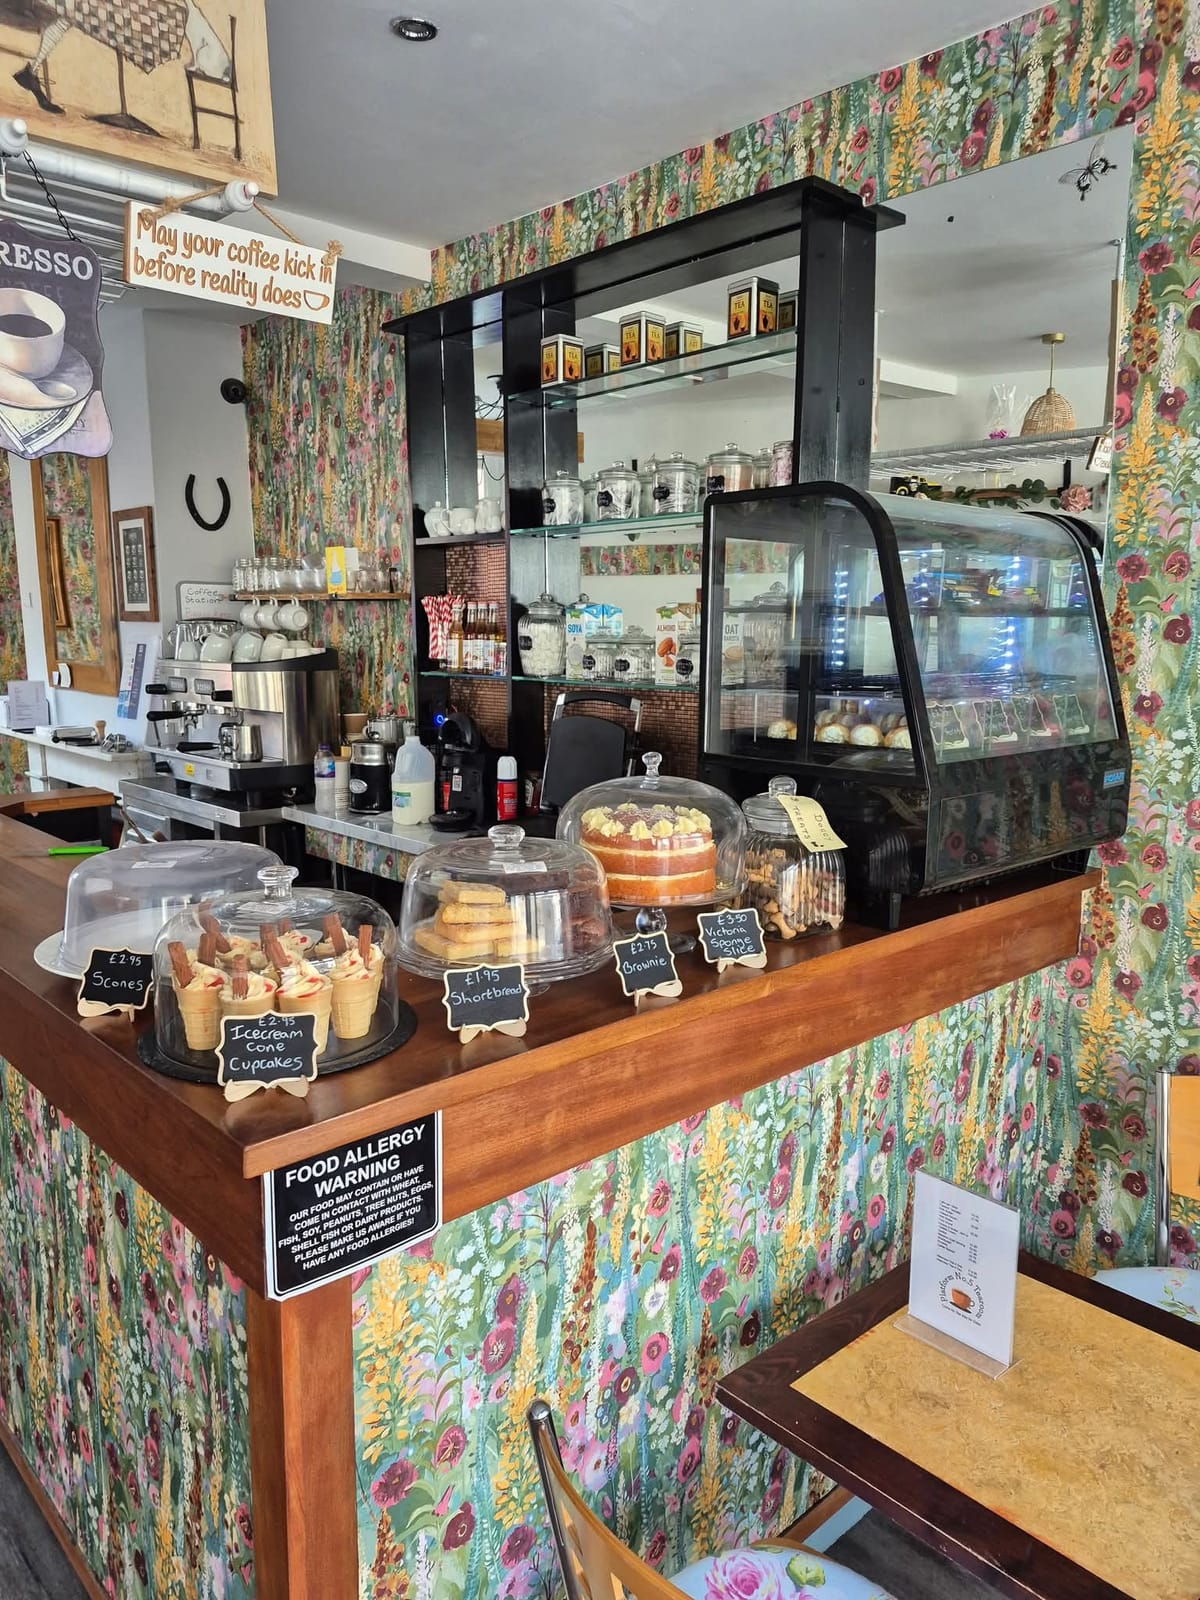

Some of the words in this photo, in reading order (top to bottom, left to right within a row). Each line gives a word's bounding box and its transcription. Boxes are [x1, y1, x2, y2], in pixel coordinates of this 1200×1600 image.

[137, 212, 177, 255] May
[182, 232, 224, 259] your
[227, 239, 280, 271] coffee
[284, 248, 315, 280] kick
[319, 262, 333, 284] in
[133, 247, 195, 285] before
[201, 269, 258, 307] reality
[262, 276, 302, 308] does
[186, 588, 218, 596] Coffee
[568, 624, 582, 633] SOYA
[724, 624, 740, 634] OAT
[705, 925, 747, 937] Victoria
[710, 937, 752, 949] Sponge
[109, 953, 142, 966] £2.95
[622, 955, 667, 974] Brownie
[92, 971, 143, 991] Scones
[465, 970, 500, 985] £1.95
[450, 984, 522, 1006] Shortbread
[230, 1025, 303, 1040] Icecream
[229, 1056, 303, 1075] Cupcakes
[285, 1155, 340, 1188] FOOD
[344, 1123, 426, 1167] ALLERGY
[314, 1154, 401, 1198] WARNING
[289, 1208, 309, 1222] OUR
[310, 1199, 335, 1215] FOOD
[335, 1191, 354, 1204] MAY
[354, 1178, 390, 1197] CONTAIN
[391, 1173, 403, 1183] OR
[403, 1164, 425, 1179] HAVE
[294, 1215, 320, 1231] COME
[321, 1210, 330, 1221] IN
[331, 1196, 370, 1216] CONTACT
[370, 1187, 391, 1201] WITH
[392, 1176, 421, 1191] WHEAT,
[278, 1234, 301, 1248] FISH,
[302, 1226, 322, 1239] SOY,
[323, 1209, 364, 1231] PEANUTS,
[364, 1199, 386, 1213] TREE
[386, 1190, 410, 1205] NUTS,
[410, 1181, 434, 1196] EGGS,
[291, 1238, 320, 1254] SHELL
[321, 1228, 340, 1243] FISH
[341, 1223, 354, 1234] OR
[354, 1211, 379, 1228] DAIRY
[380, 1195, 424, 1218] PRODUCTS.
[294, 1244, 329, 1263] PLEASE
[330, 1233, 354, 1250] MAKE
[355, 1228, 367, 1239] US
[368, 1217, 395, 1234] AWARE
[396, 1212, 404, 1221] IF
[405, 1205, 422, 1217] YOU
[302, 1255, 327, 1271] HAVE
[327, 1247, 345, 1261] ANY
[346, 1237, 370, 1253] FOOD
[370, 1217, 415, 1243] ALLERGIES!
